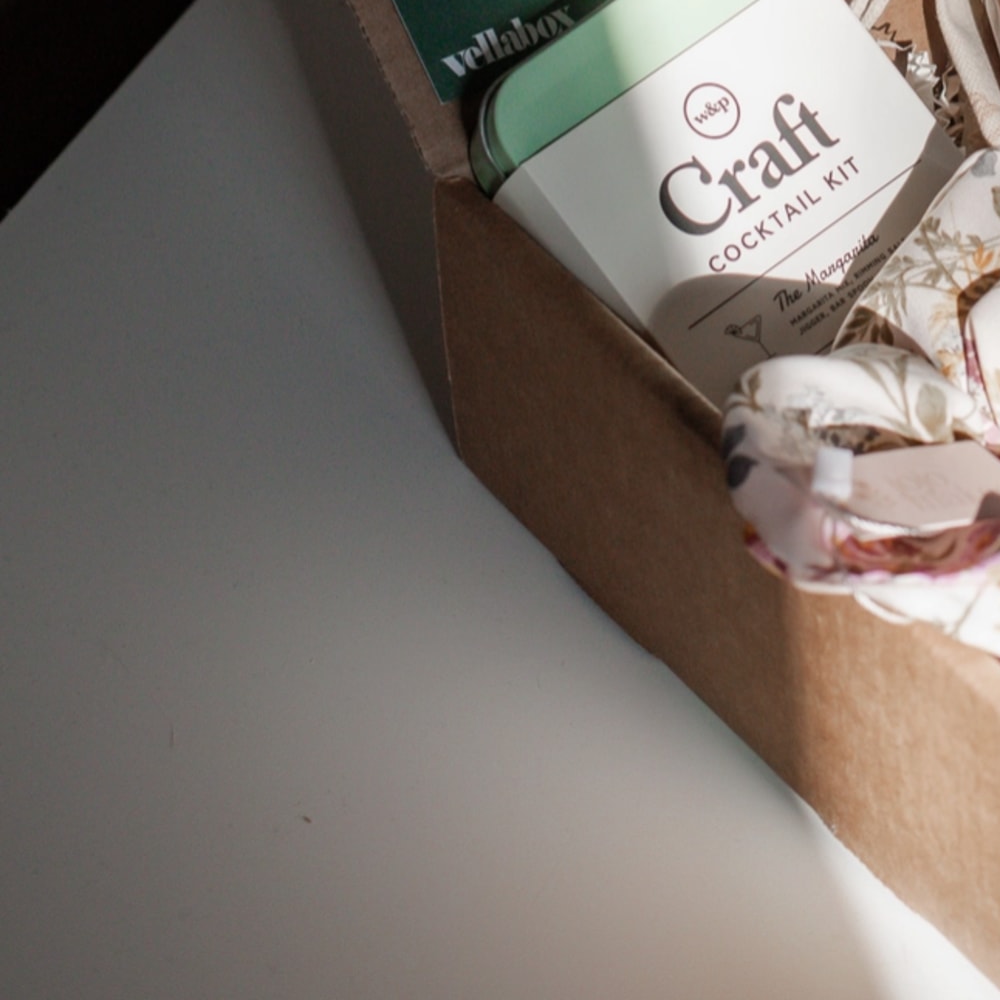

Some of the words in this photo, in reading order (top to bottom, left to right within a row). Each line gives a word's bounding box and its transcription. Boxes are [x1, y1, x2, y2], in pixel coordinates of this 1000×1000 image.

[441, 4, 576, 78] vellabox
[693, 95, 730, 126] w&p
[658, 92, 841, 238] Craft
[708, 189, 822, 273] COCKTAIL
[823, 155, 861, 190] KIT
[773, 288, 803, 312] The
[804, 233, 880, 292] Margarita
[789, 291, 834, 327] MARGARITA
[829, 297, 846, 313] BAR
